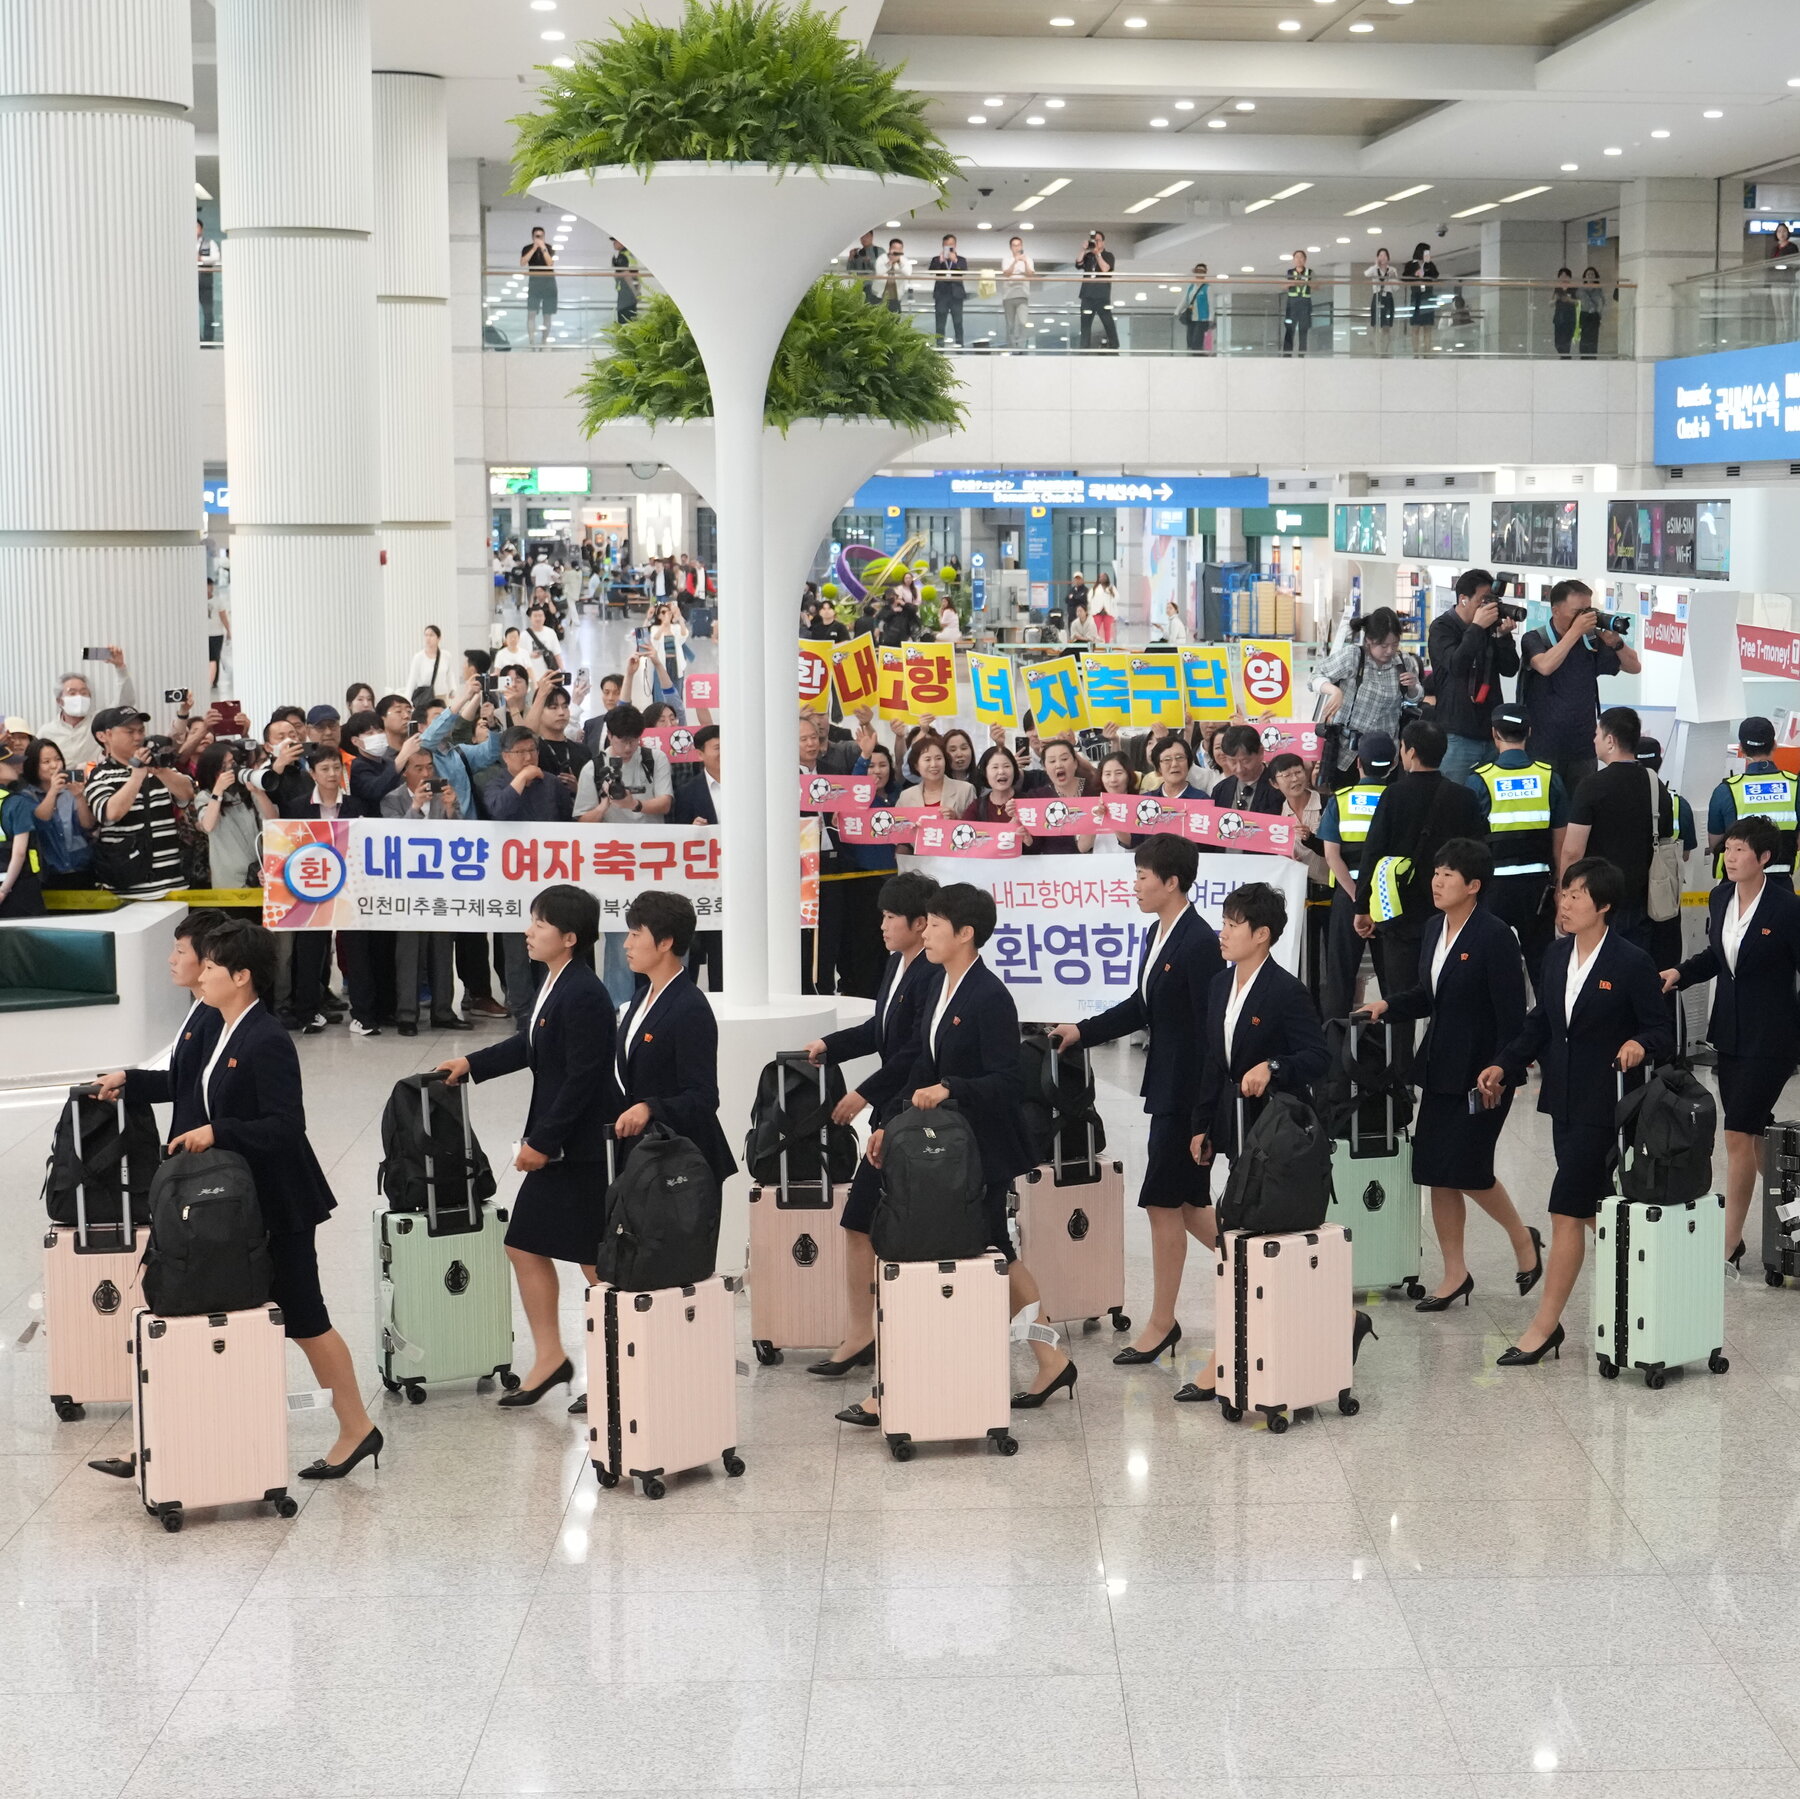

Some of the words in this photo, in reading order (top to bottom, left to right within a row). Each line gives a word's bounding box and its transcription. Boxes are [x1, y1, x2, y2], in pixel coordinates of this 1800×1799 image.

[1715, 382, 1780, 431] 국내선수속
[1088, 483, 1152, 501] 국내선수속
[1741, 637, 1756, 658] Free
[1756, 639, 1790, 669] T-money!
[833, 645, 878, 703] 내
[1086, 665, 1131, 714] 축
[1132, 665, 1180, 714] 구
[1184, 659, 1228, 708] 단
[1247, 658, 1284, 699] 영
[691, 681, 712, 700] 환
[1030, 671, 1080, 724] 자
[853, 784, 871, 803] 영
[1499, 778, 1536, 792] 경찰
[1500, 790, 1536, 798] POLICE
[1748, 783, 1785, 795] 경찰
[1749, 794, 1785, 802] POLICE
[844, 816, 863, 836] 환
[1018, 807, 1038, 827] 환
[1108, 801, 1129, 824] 환
[1189, 812, 1211, 835] 환
[1268, 823, 1289, 844] 영
[923, 826, 944, 848] 환
[996, 830, 1016, 851] 영
[299, 857, 332, 889] 환
[364, 835, 490, 882] 내고향
[501, 838, 585, 882] 여자
[592, 838, 722, 881] 축구단
[357, 895, 523, 918] 인천미추홀구체육회
[992, 879, 1138, 910] 내고향여자축
[993, 922, 1149, 985] 환영합
